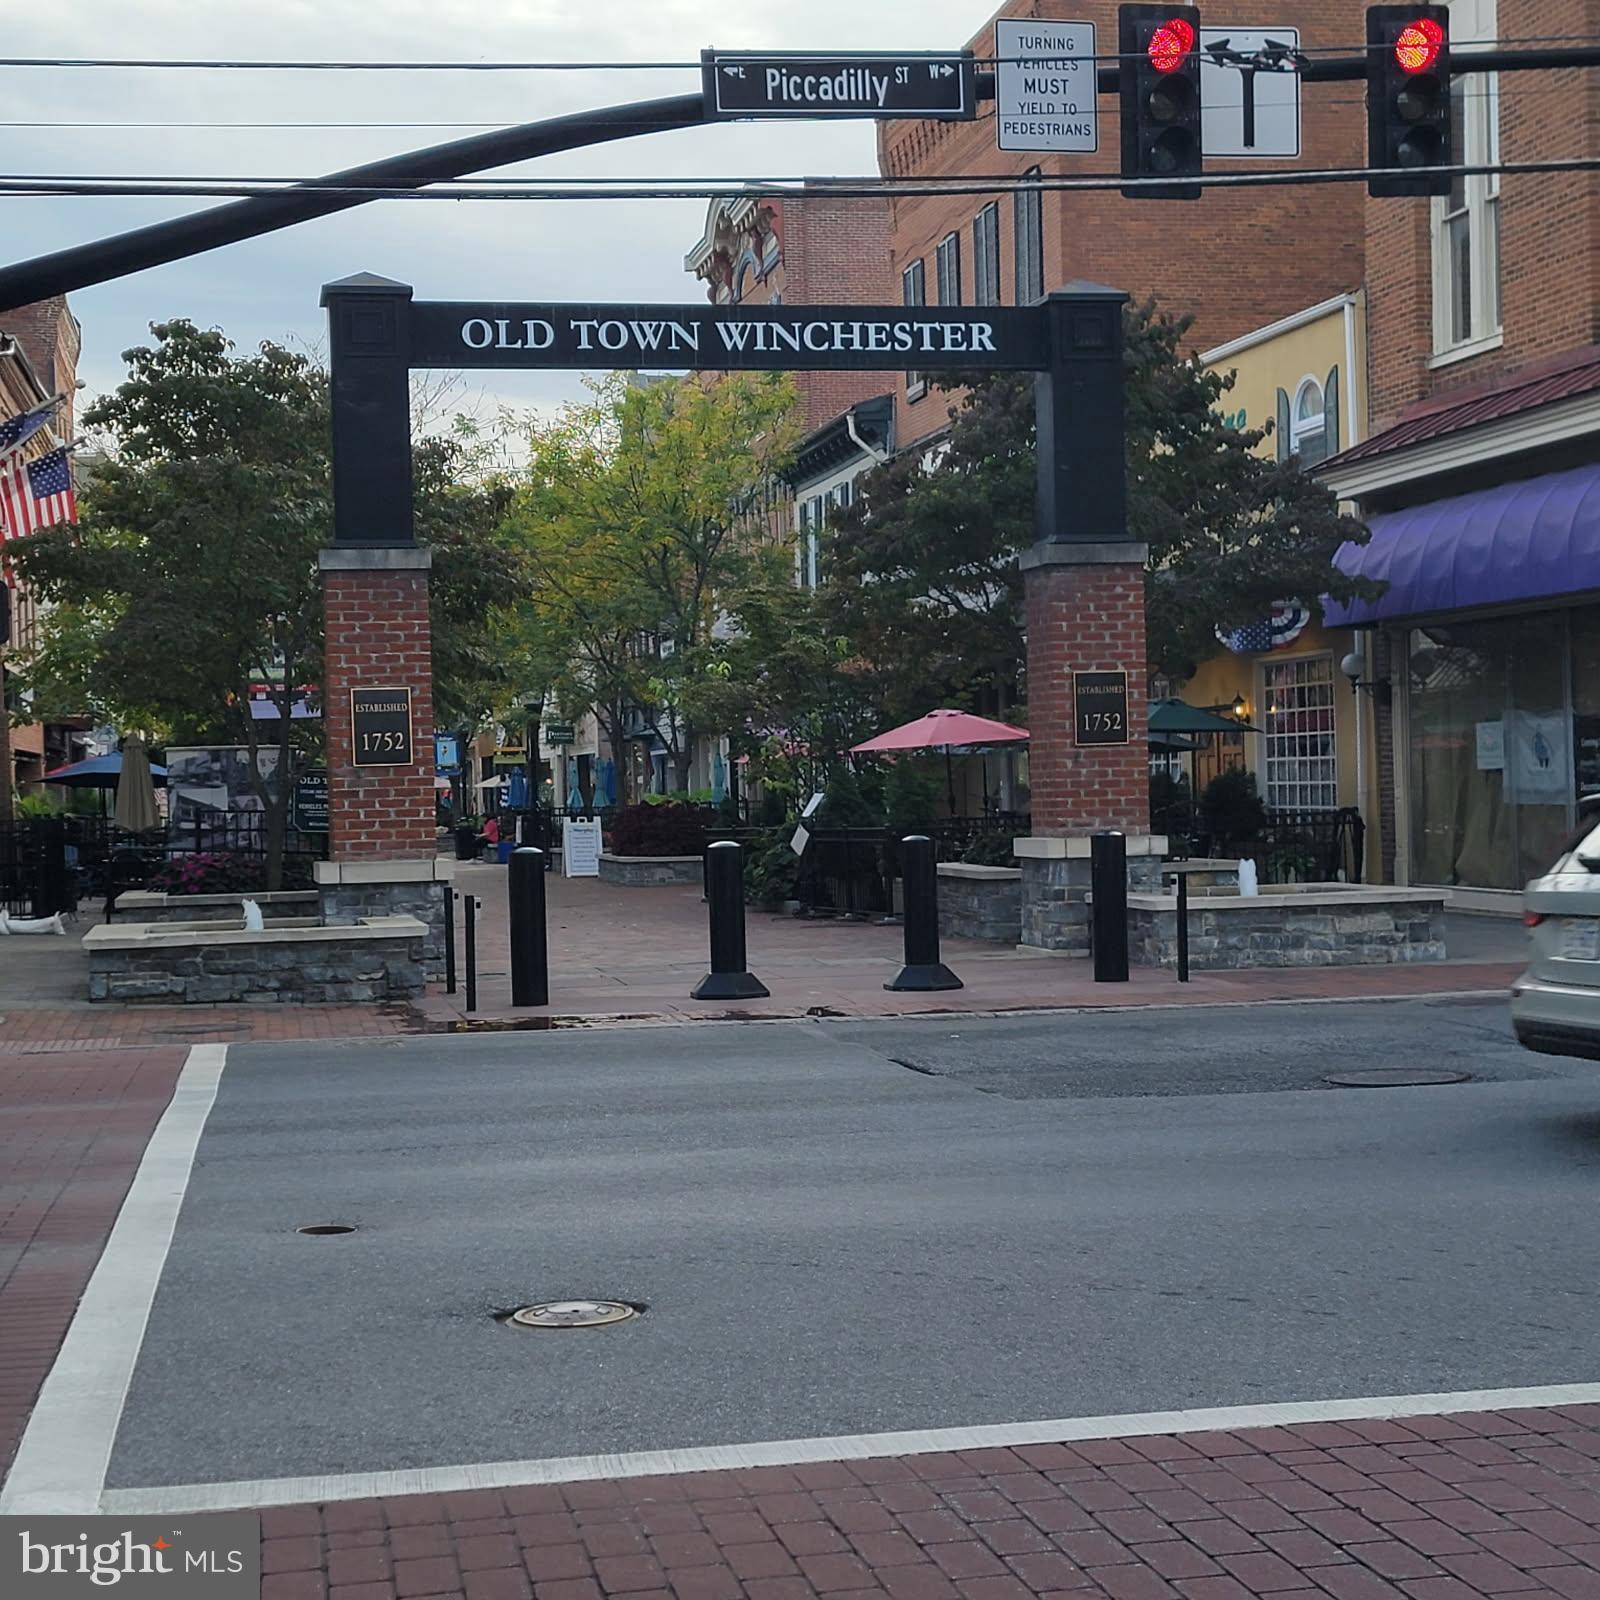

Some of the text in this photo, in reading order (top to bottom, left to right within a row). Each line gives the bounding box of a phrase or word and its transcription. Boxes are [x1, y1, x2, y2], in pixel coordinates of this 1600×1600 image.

[1018, 36, 1075, 51] TURNING
[1016, 57, 1079, 71] VEHICLES
[766, 68, 889, 107] Piccadilly
[895, 66, 909, 84] ST
[929, 64, 939, 79] W
[1024, 78, 1070, 95] MUST
[1018, 102, 1078, 115] YIELD TO
[1003, 122, 1092, 136] PEDESTRIANS
[461, 319, 997, 353] OLD TOWN WINCHESTER
[1077, 685, 1125, 694] ESTABLISHED
[355, 703, 408, 712] ESTABLISHED
[1084, 712, 1122, 731] 1752
[362, 732, 404, 752] 1752
